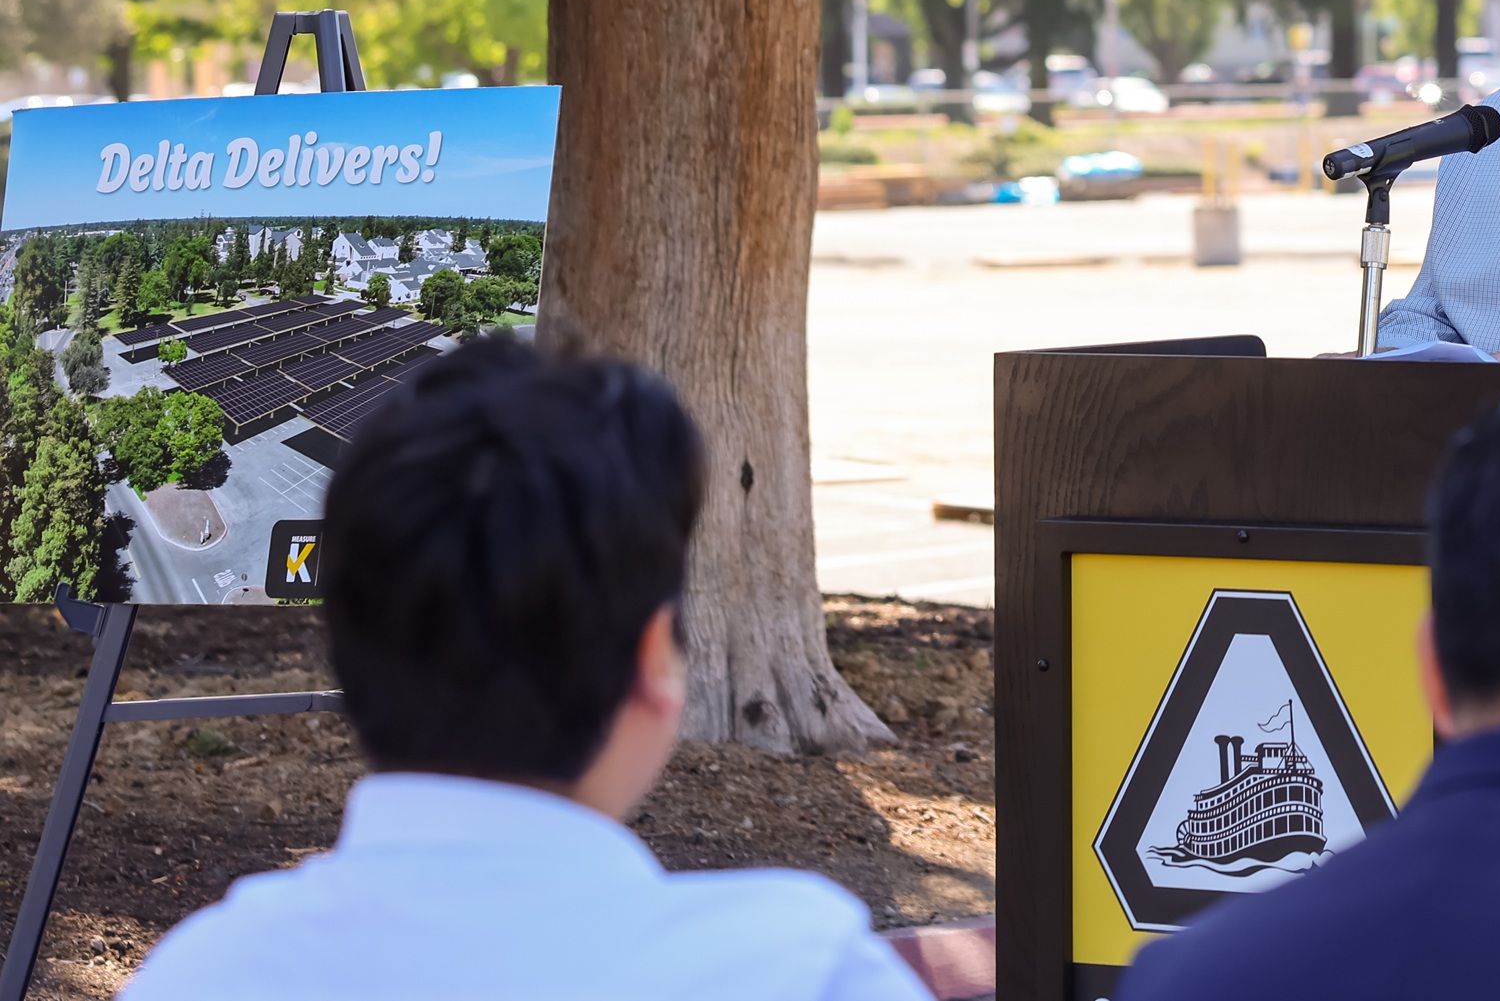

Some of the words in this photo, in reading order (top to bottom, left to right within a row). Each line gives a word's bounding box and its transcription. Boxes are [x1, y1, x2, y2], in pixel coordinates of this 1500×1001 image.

[95, 138, 215, 194] Delta
[222, 130, 443, 190] Delivers!
[286, 543, 316, 582] K
